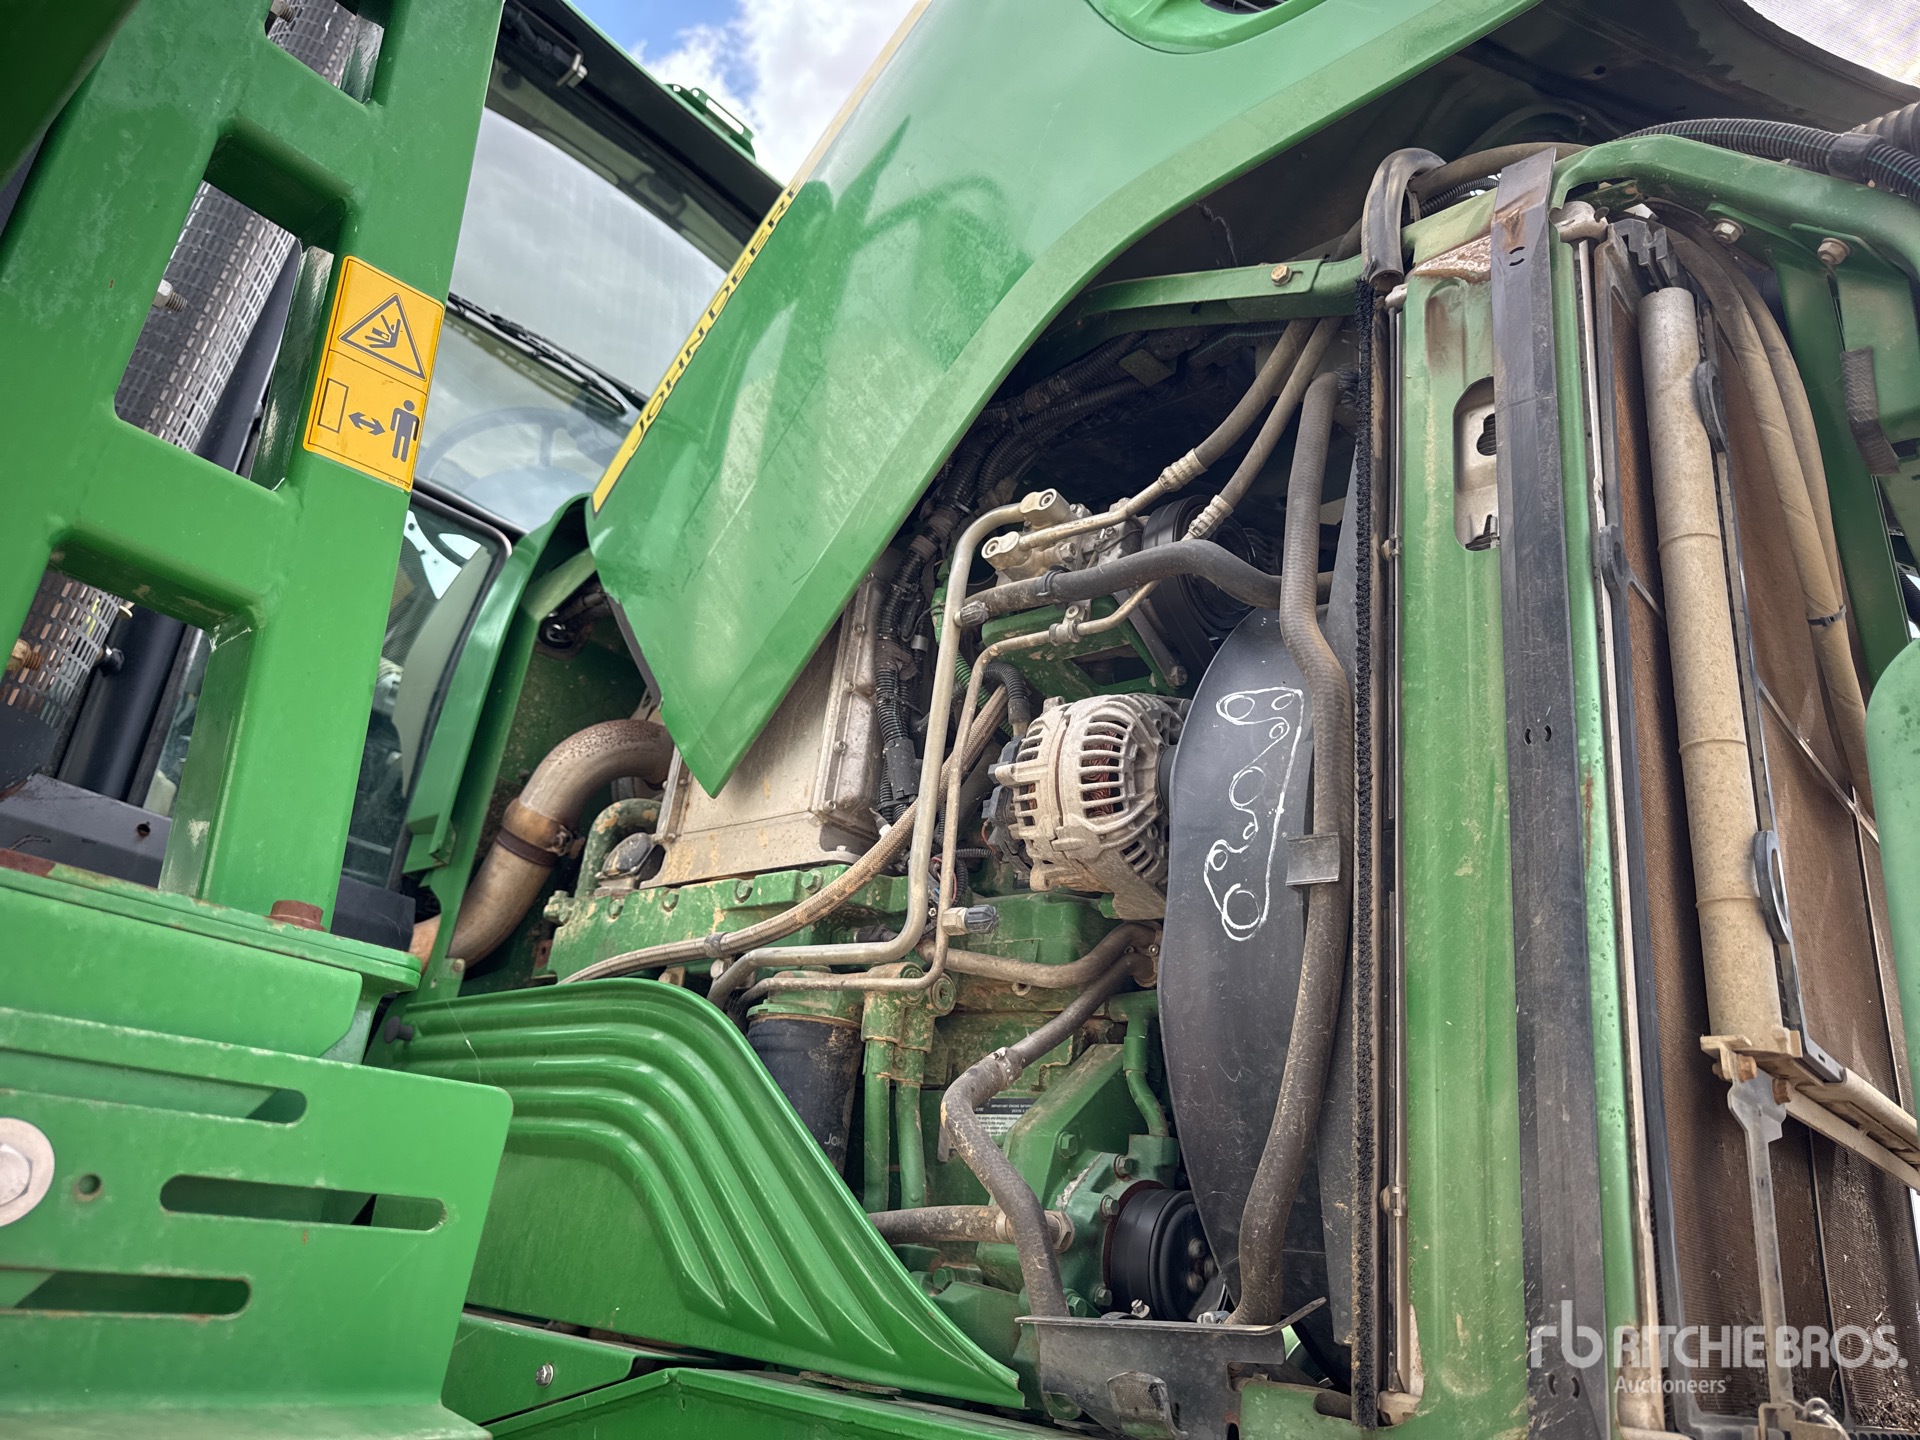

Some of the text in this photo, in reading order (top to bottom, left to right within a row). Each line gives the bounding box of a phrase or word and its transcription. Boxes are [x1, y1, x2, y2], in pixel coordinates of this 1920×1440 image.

[630, 177, 804, 450] JOHN DEERE
[824, 1133, 844, 1147] JOH
